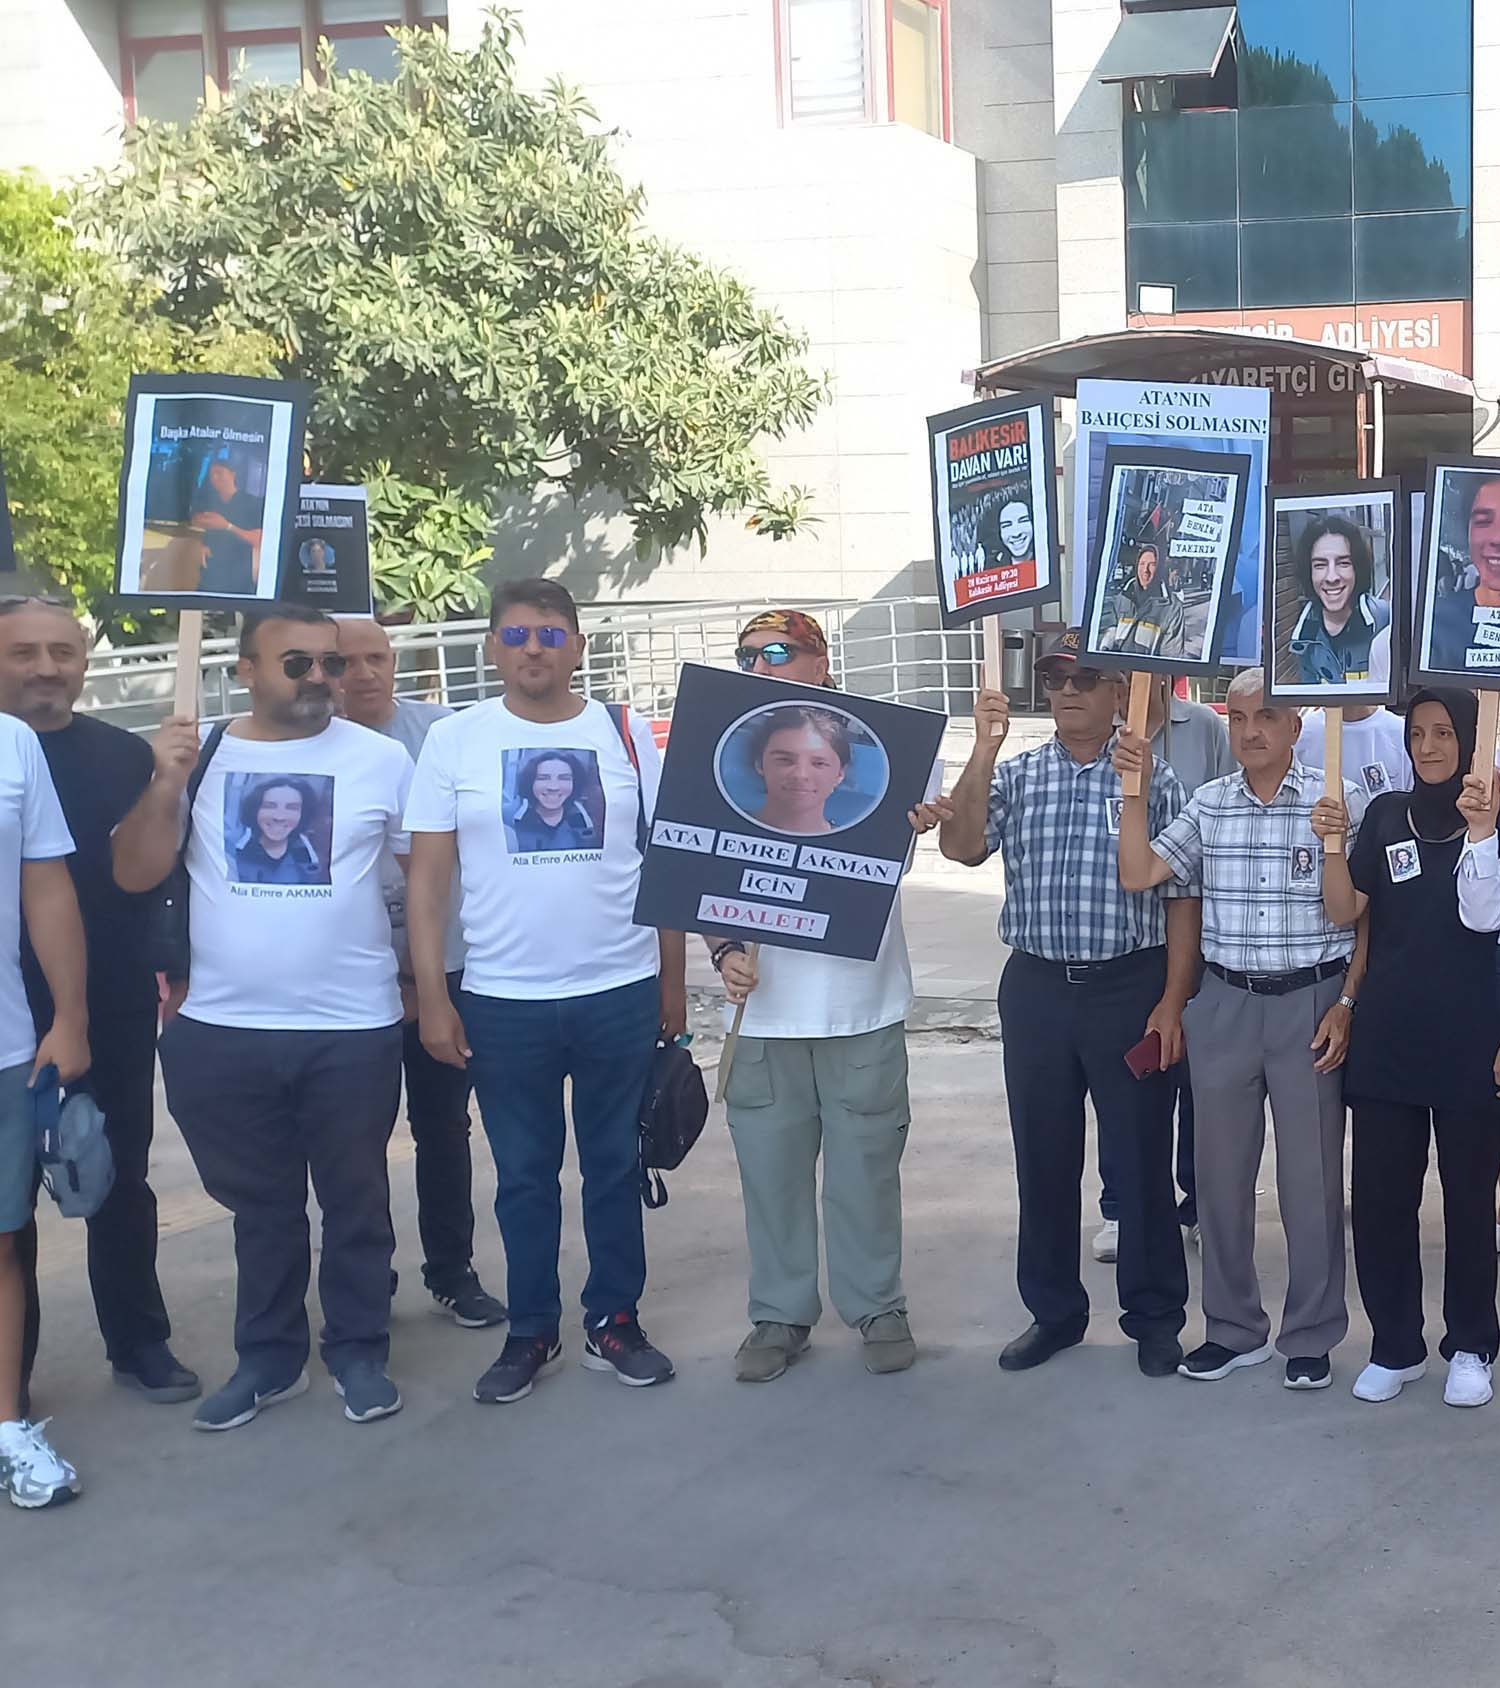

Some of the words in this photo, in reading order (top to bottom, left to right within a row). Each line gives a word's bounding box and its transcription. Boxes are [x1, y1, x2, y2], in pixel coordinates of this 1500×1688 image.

[1321, 313, 1440, 349] ADLİYESİ
[1190, 360, 1317, 397] YARETÇİ
[1138, 390, 1212, 408] ATA'NIN
[1081, 410, 1161, 430] BAHÇESİ
[1165, 414, 1267, 435] SOLMASIN!
[189, 425, 221, 439] Atalar
[222, 427, 264, 443] ölmesin
[950, 420, 1026, 461] BALIKESİR
[994, 443, 1028, 470] VAR!
[1197, 503, 1214, 513] ATA
[1187, 519, 1216, 535] BENİM
[1176, 543, 1216, 554] YAKINIM
[512, 856, 529, 865] Ata
[532, 855, 560, 865] Emre
[563, 853, 602, 863] AKMAN
[656, 827, 702, 847] ATA
[722, 839, 791, 862] EMRE
[802, 852, 891, 879] AKMAN
[230, 885, 248, 896] Ata
[251, 887, 283, 898] Emre
[286, 888, 332, 898] AKMAN
[746, 873, 796, 895] İÇİN
[703, 903, 816, 932] ADALET!
